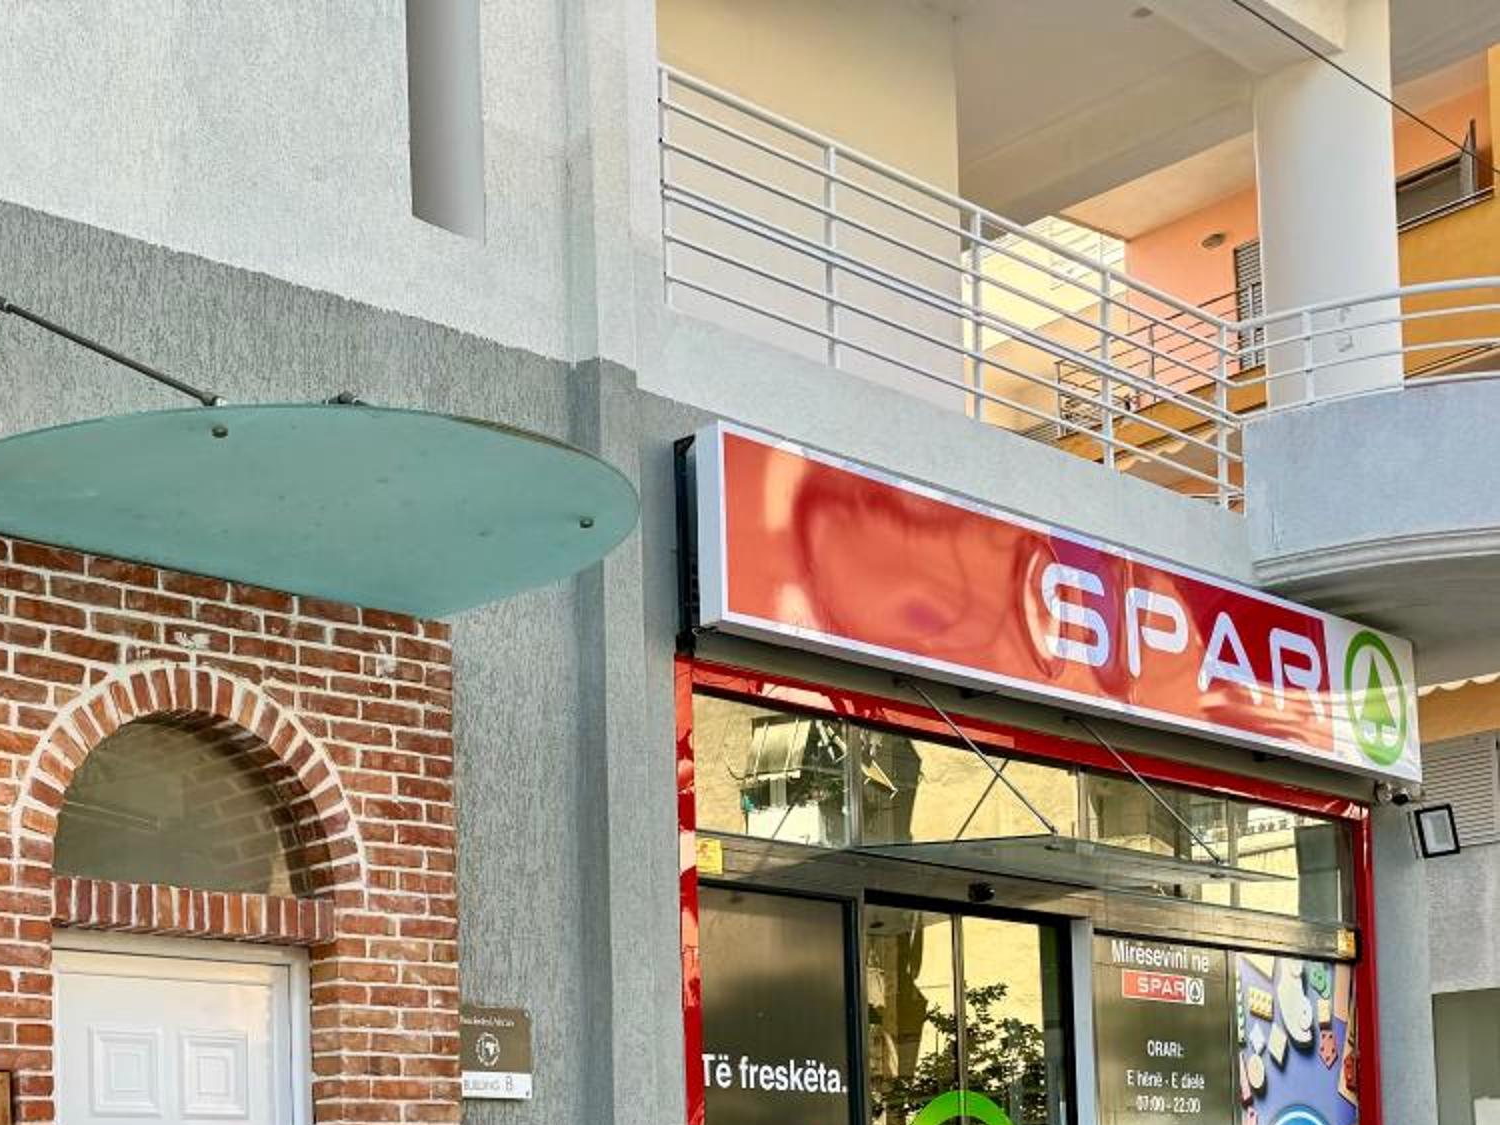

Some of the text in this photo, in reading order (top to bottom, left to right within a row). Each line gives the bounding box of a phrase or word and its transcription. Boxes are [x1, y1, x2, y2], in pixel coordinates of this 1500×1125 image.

[1041, 563, 1325, 724] SPAR
[1137, 976, 1186, 998] SPAR
[702, 1053, 848, 1093] Të freskëta.
